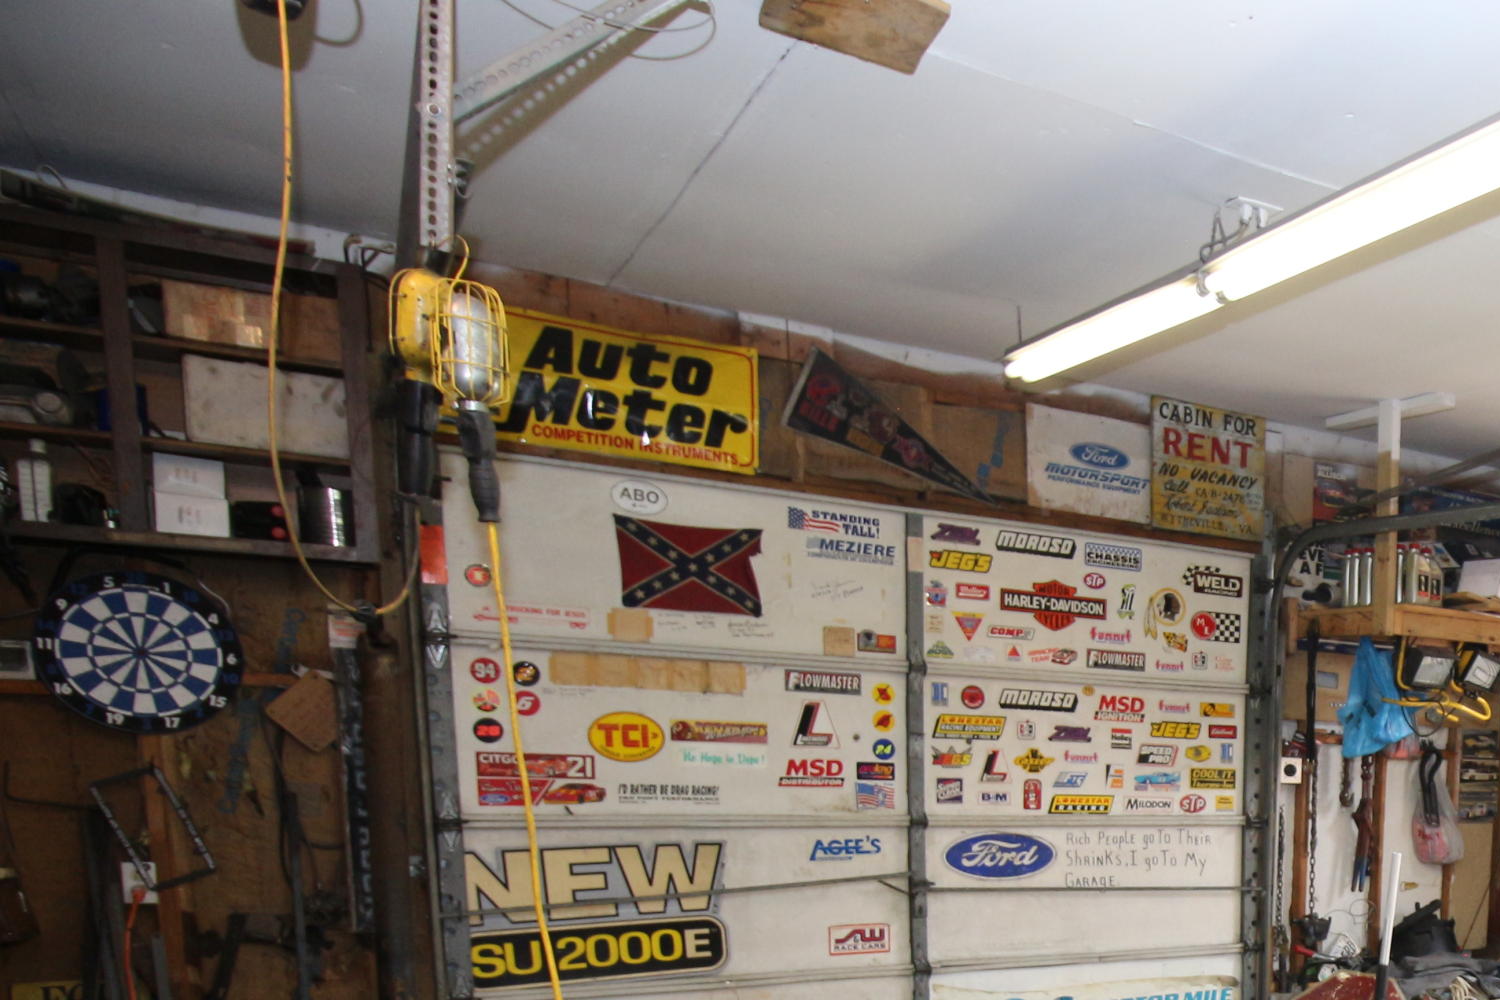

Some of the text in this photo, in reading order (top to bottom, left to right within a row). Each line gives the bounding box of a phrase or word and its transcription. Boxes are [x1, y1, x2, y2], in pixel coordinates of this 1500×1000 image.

[524, 325, 714, 397] Auto
[500, 370, 748, 449] Meter
[1159, 402, 1257, 437] CABIN FOR
[531, 424, 740, 465] COMPETITION INSTRUMENTS
[1163, 426, 1254, 469] RENT
[1081, 448, 1119, 467] Ford
[1044, 462, 1150, 489] MOTORSPORT
[1158, 462, 1258, 490] NO VACANCY
[620, 486, 660, 504] ABO
[812, 510, 881, 526] STANDING
[842, 523, 881, 539] TALL!
[820, 538, 897, 558] MEZIERE
[998, 530, 1077, 555] MOROSO
[930, 550, 993, 573] JEG'S
[1086, 551, 1140, 565] CHASSIS
[103, 576, 115, 588] 5
[162, 582, 171, 593] 1
[1086, 573, 1104, 587] STP
[1195, 574, 1241, 591] WELD
[55, 598, 68, 610] 9
[1003, 592, 1105, 616] HARLEY-DAVIDSON
[207, 613, 220, 625] 4
[990, 627, 1024, 637] COMP
[35, 637, 53, 650] 11
[226, 653, 237, 665] 6
[1088, 651, 1145, 668] FLOWMASTER
[473, 662, 496, 679] 94
[53, 682, 73, 695] 16
[788, 673, 861, 691] FLOWMASTER
[209, 694, 228, 708] 15
[517, 696, 535, 709] 6
[999, 688, 1078, 711] MOROSO
[1098, 694, 1145, 713] MSD
[106, 712, 126, 725] 19
[163, 717, 181, 729] 17
[1097, 711, 1142, 723] IGNITION
[597, 723, 650, 748] TCI
[1111, 734, 1132, 743] Holley
[1151, 721, 1201, 740] JEG'S
[566, 755, 593, 778] 21
[785, 758, 845, 777] MSD
[1192, 769, 1219, 779] COOL
[618, 783, 720, 797] I'D RATHER BE DRAG RACING!
[1126, 798, 1172, 811] MILODON
[1181, 795, 1206, 811] STP
[1066, 832, 1090, 845] Rich
[809, 835, 882, 861] AGEE'S
[960, 839, 1039, 868] Ford
[1184, 852, 1207, 876] My
[464, 843, 723, 926] NEW
[472, 928, 713, 979] SU 2000E
[861, 942, 886, 950] CARS
